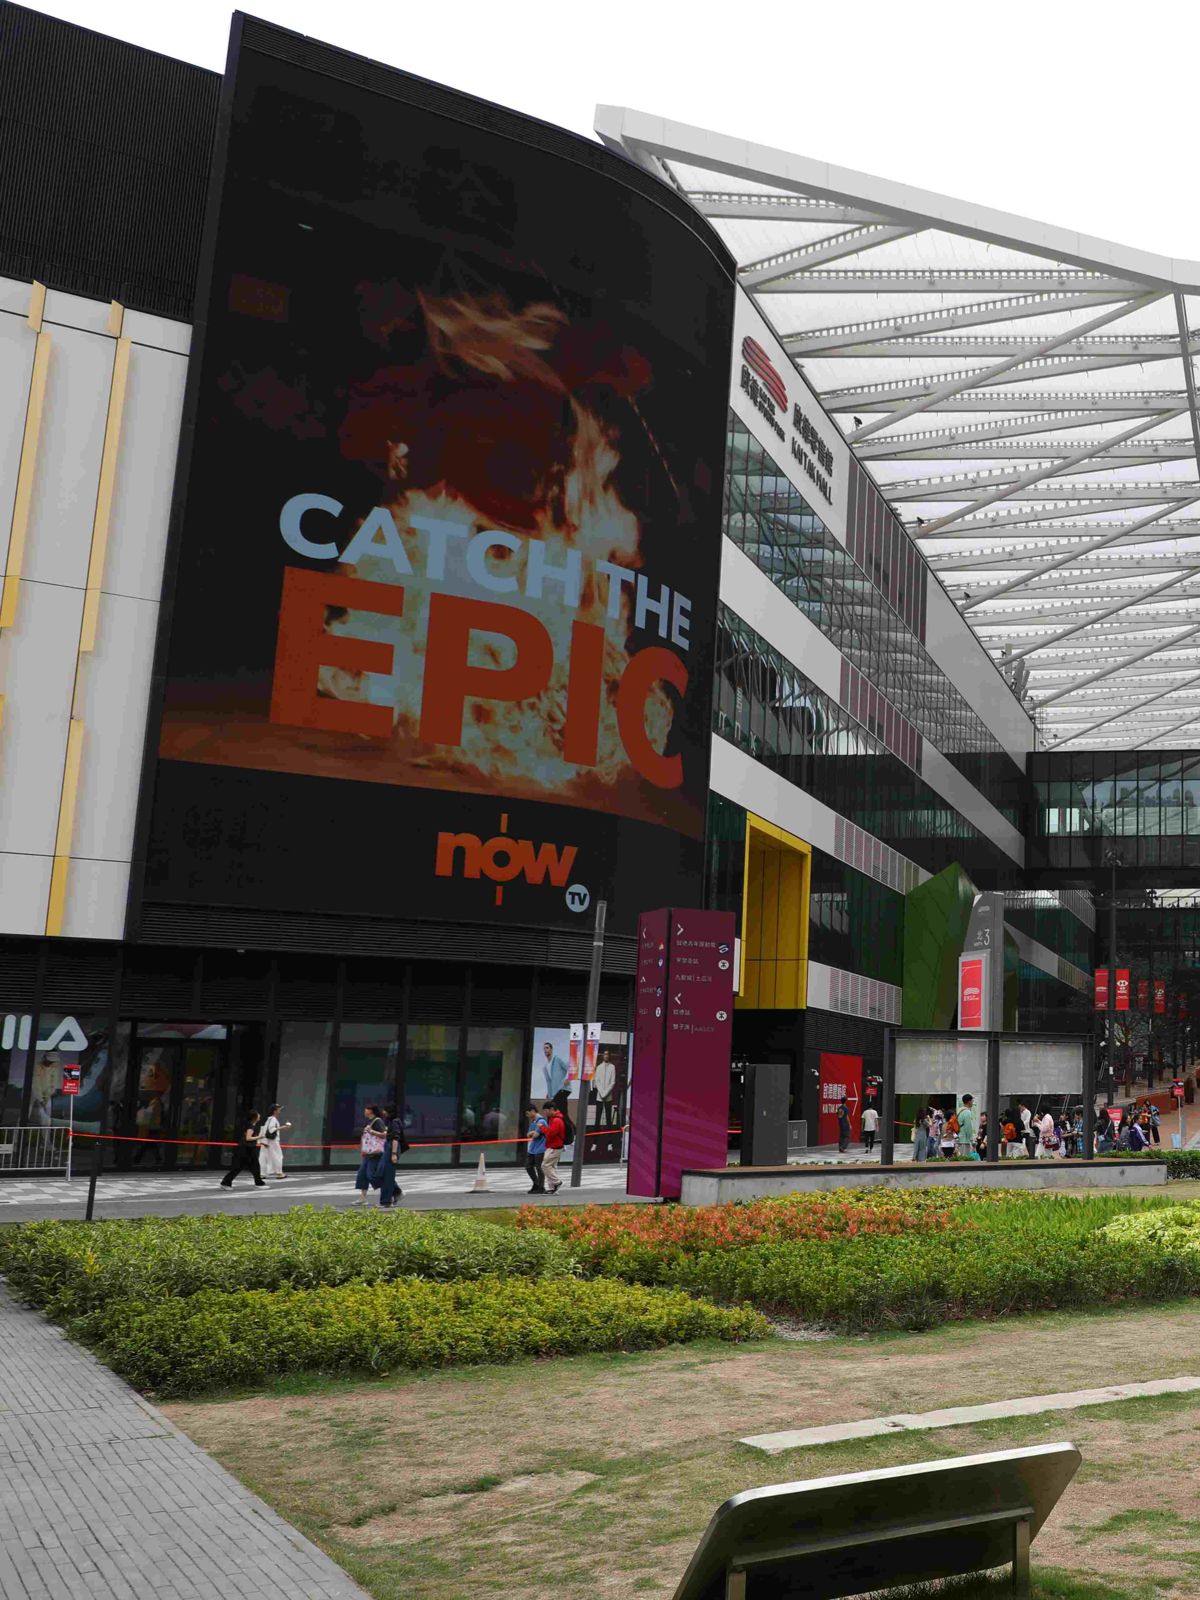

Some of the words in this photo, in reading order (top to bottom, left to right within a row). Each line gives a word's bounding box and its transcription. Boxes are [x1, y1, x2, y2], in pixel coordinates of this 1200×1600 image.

[278, 492, 580, 609] CATCH
[596, 559, 692, 652] THE
[270, 566, 689, 789] EPIC
[435, 828, 578, 890] now
[568, 891, 588, 906] TV
[984, 928, 990, 946] 3
[1, 1014, 88, 1052] ILA
